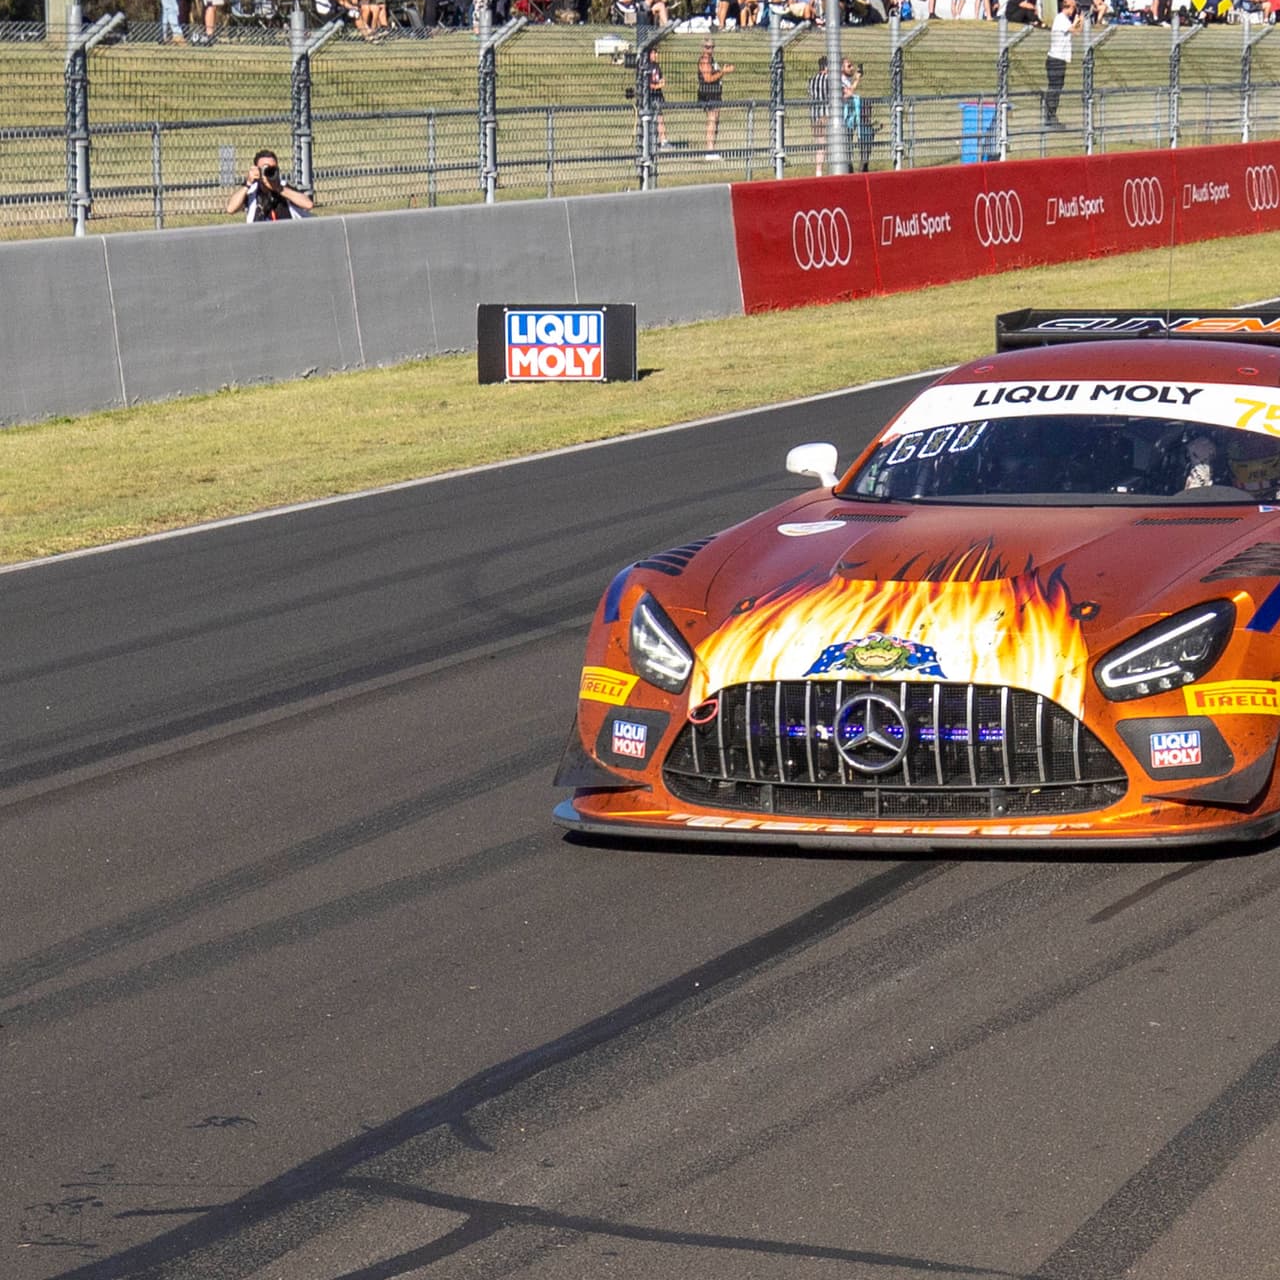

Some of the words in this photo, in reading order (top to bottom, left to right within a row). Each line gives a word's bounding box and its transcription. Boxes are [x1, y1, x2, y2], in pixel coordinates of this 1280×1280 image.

[1191, 184, 1207, 203] Audi
[1208, 181, 1230, 200] Sport
[1058, 198, 1077, 219] Audi
[1079, 195, 1105, 216] Sport
[895, 217, 919, 239] Audi
[920, 213, 951, 237] Sport
[510, 314, 599, 345] LIQUI
[510, 346, 600, 378] MOLY
[972, 384, 1076, 407] LIQUI
[1089, 383, 1205, 406] MOLY
[1195, 688, 1278, 709] PIRELLI
[614, 722, 647, 742] LIQUI
[1153, 732, 1199, 751] LIQUI
[613, 739, 646, 757] MOLY
[1154, 749, 1200, 767] MOLY
